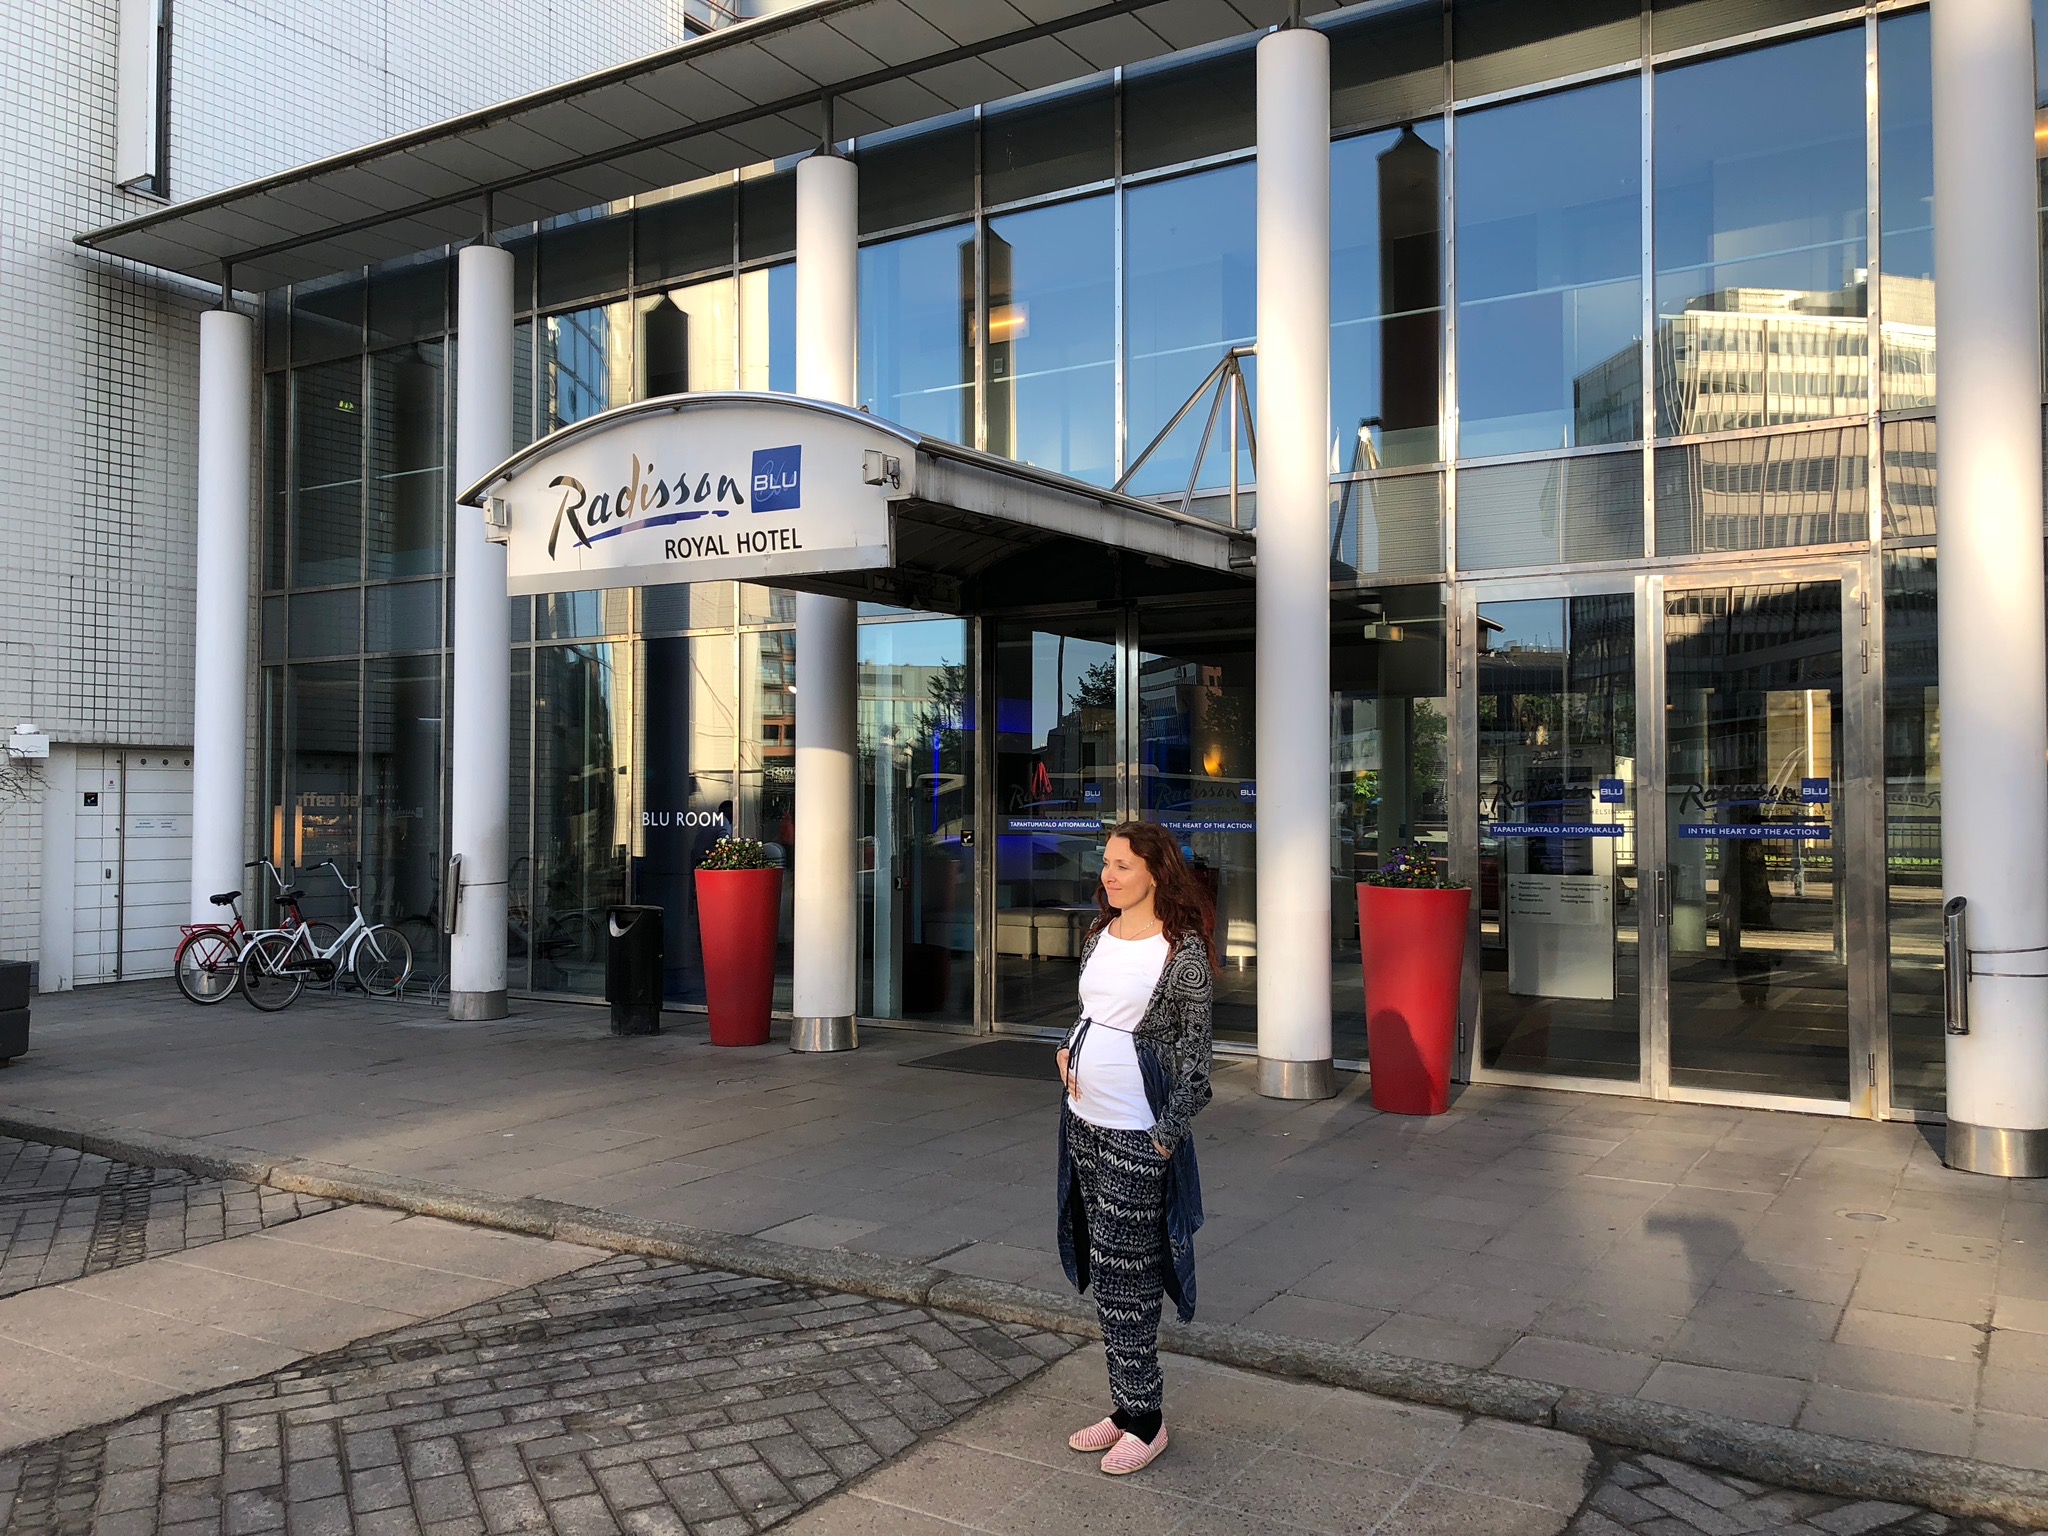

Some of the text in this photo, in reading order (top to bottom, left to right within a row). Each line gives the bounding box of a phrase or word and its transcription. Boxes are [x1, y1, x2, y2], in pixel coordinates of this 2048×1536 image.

[547, 453, 798, 561] Radisson BLU
[665, 527, 803, 560] ROYAL HOTEL
[642, 811, 724, 828] BLU ROOM
[1226, 822, 1253, 830] ACTION
[1492, 826, 1623, 834] TAPAHTUMATALO AITIOPAIKALLA
[1687, 827, 1821, 836] IN THE HEART OF THE ACTION
